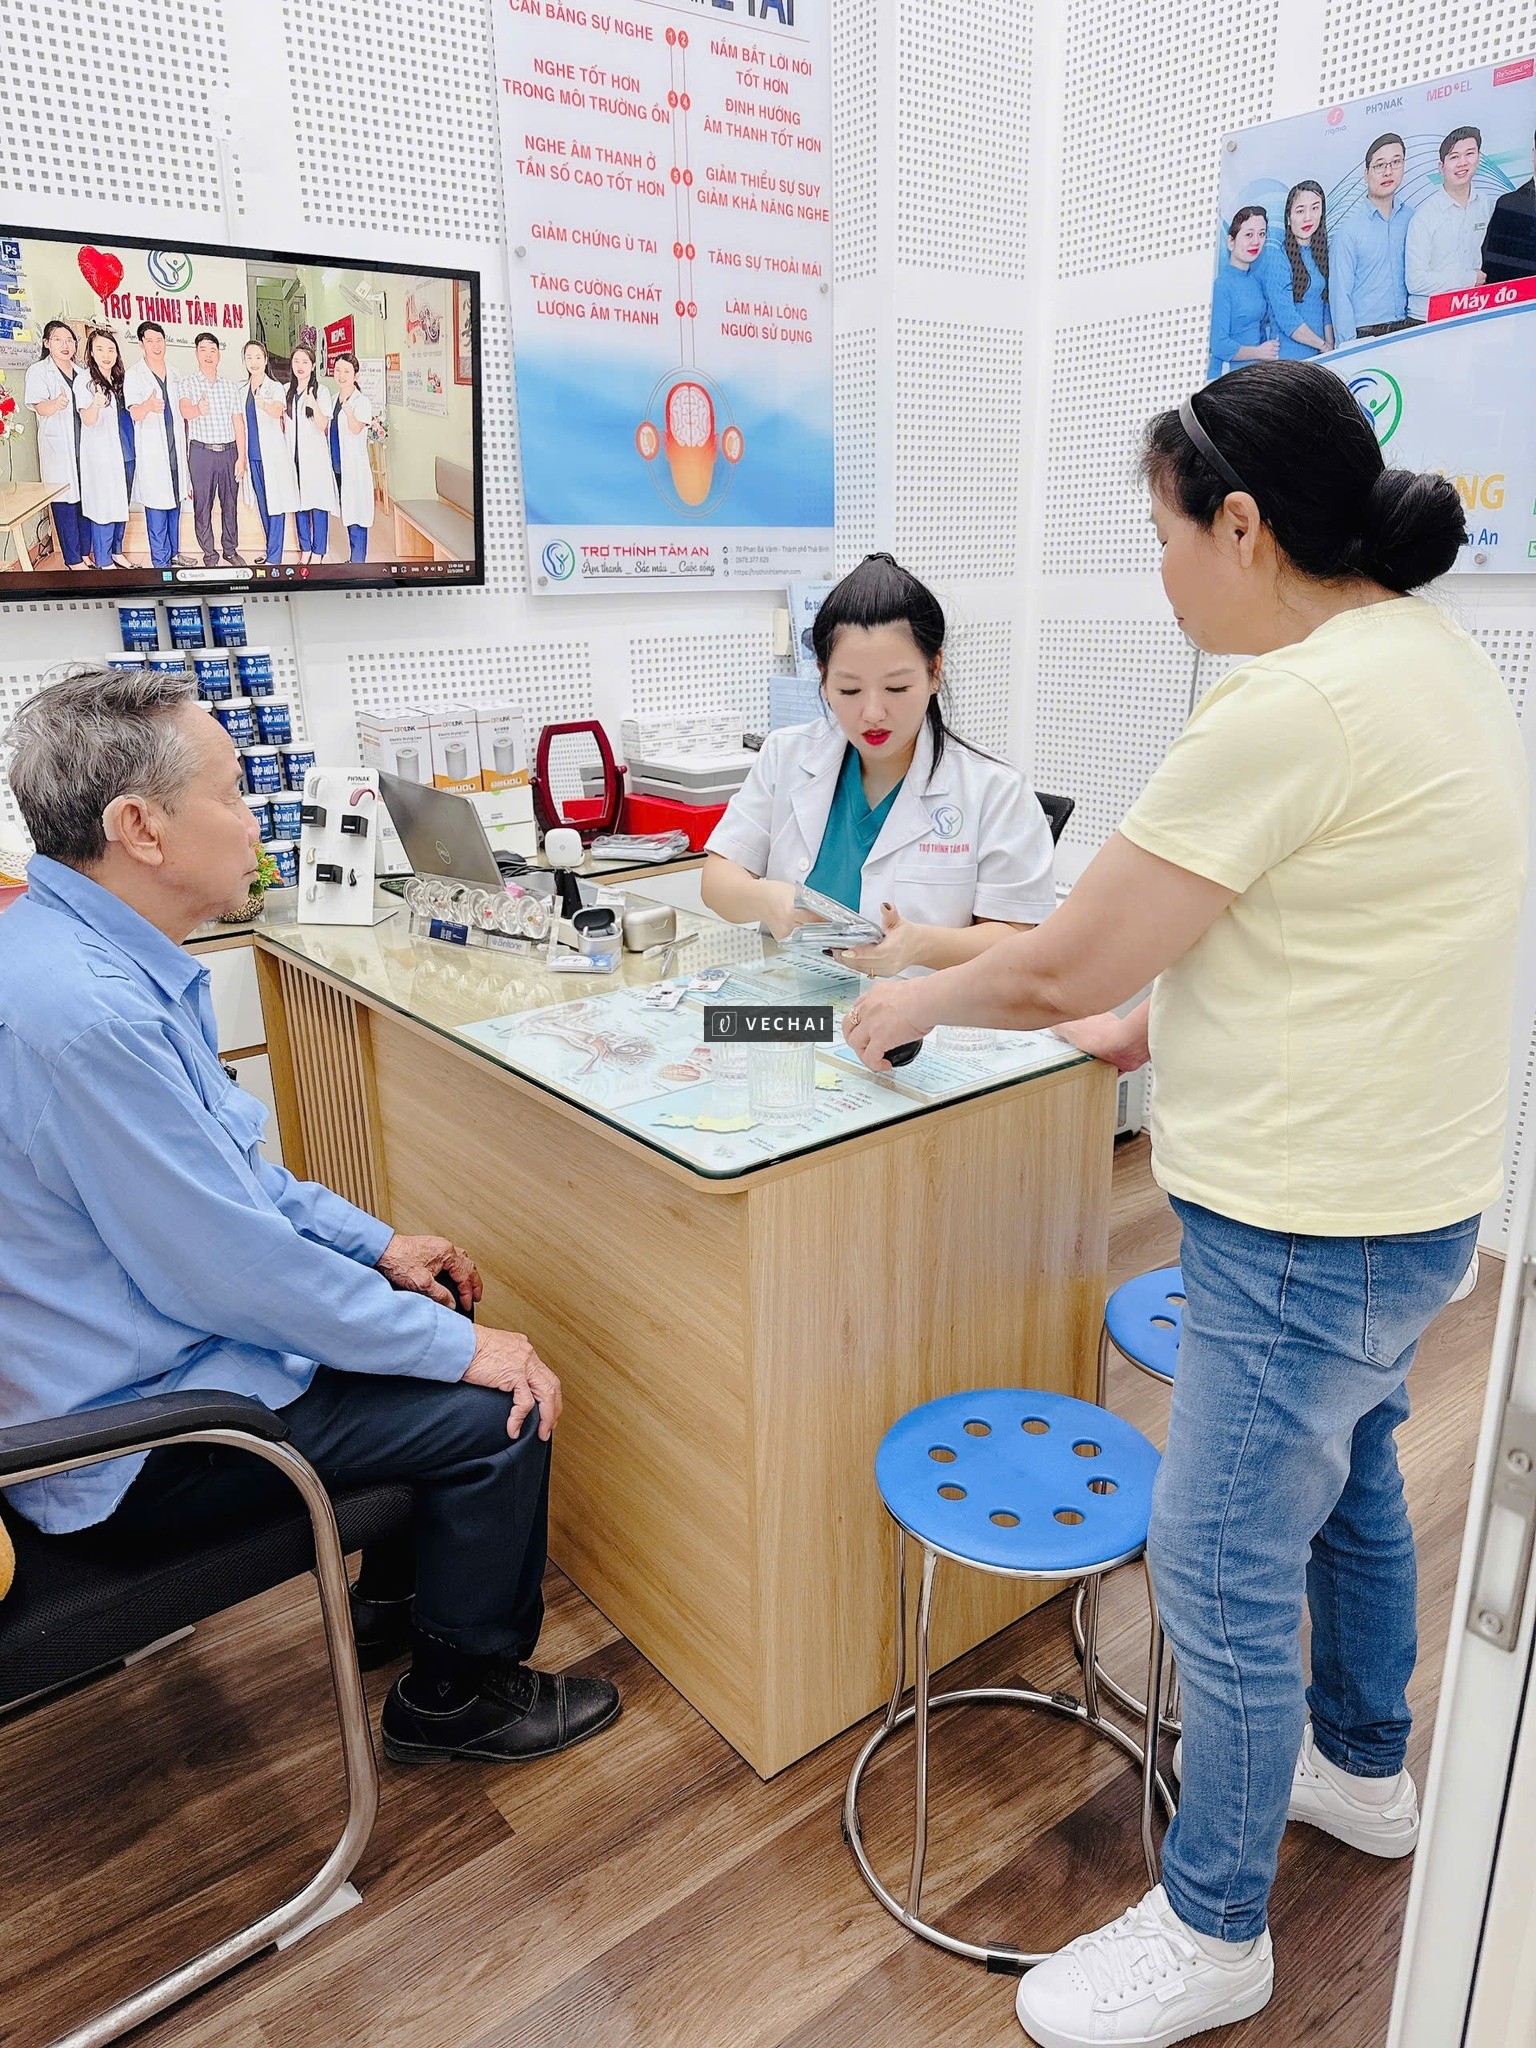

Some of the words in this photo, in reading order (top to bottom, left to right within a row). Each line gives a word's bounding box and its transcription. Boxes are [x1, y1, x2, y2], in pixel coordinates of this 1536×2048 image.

[546, 1, 587, 26] BẰNG
[591, 14, 610, 34] SỰ
[614, 19, 653, 41] NGHE
[711, 37, 738, 60] NẮM
[742, 44, 766, 66] BẮT
[769, 53, 788, 71] LỜI
[792, 58, 812, 76] NÓI
[534, 58, 575, 80] NGHE
[580, 65, 606, 86] TỐT
[611, 75, 640, 93] HƠN
[736, 68, 760, 88] TỐT
[763, 78, 789, 95] HƠN
[1496, 66, 1523, 80] ReSound
[502, 78, 555, 102] TRONG
[560, 88, 585, 108] MÔI
[589, 95, 647, 119] TRƯỜNG
[725, 98, 755, 116] ĐỊNH
[759, 106, 801, 126] HƯỚNG
[1365, 97, 1403, 114] PHONAK
[704, 115, 722, 134] ÂM
[726, 123, 767, 142] THANH
[771, 128, 793, 148] TỐT
[797, 137, 821, 153] HƠN
[525, 135, 566, 155] NGHE
[571, 140, 591, 159] ÂM
[595, 147, 642, 168] THANH
[646, 151, 656, 171] Ở
[516, 155, 545, 178] TẦN
[550, 162, 570, 181] SỐ
[574, 169, 603, 187] CAO
[607, 171, 632, 191] TỐT
[637, 180, 665, 197] HƠN
[706, 164, 737, 185] GIẢM
[741, 170, 776, 191] THIỂU
[779, 180, 795, 198] SỰ
[798, 182, 821, 198] SUY
[697, 187, 728, 207] GIẢM
[732, 193, 757, 212] KHẢ
[761, 198, 793, 216] NĂNG
[797, 205, 829, 222] NGHE
[5, 245, 17, 255] Ps
[531, 220, 567, 242] GIẢM
[572, 229, 621, 249] CHỨNG
[625, 234, 634, 251] Ù
[638, 238, 657, 254] TAI
[708, 249, 741, 267] TĂNG
[745, 255, 762, 272] SỰ
[802, 261, 822, 277] MÁI
[530, 272, 570, 292] TĂNG
[574, 278, 623, 298] CƯỜNG
[627, 283, 662, 302] CHẤT
[1450, 291, 1490, 312] Máy
[1494, 286, 1518, 303] đo
[102, 292, 131, 325] TRỢ
[135, 291, 182, 324] THÍNH
[186, 295, 218, 327] TÂM
[222, 304, 243, 328] AN
[537, 300, 585, 319] LƯỢNG
[590, 302, 610, 320] ÂM
[614, 308, 659, 325] THANH
[725, 298, 750, 316] LÀM
[754, 301, 773, 318] HÀI
[776, 304, 808, 321] LÒNG
[721, 322, 758, 339] NGƯỜI
[762, 323, 778, 340] SỬ
[781, 328, 812, 344] DỤNG
[1478, 528, 1498, 545] An
[580, 545, 610, 560] TRỢ
[613, 543, 656, 557] THÍNH
[660, 543, 687, 557] TÂM
[691, 547, 709, 557] AN
[582, 559, 599, 574] Âm
[601, 562, 622, 573] thanh
[497, 938, 522, 950] Beltone
